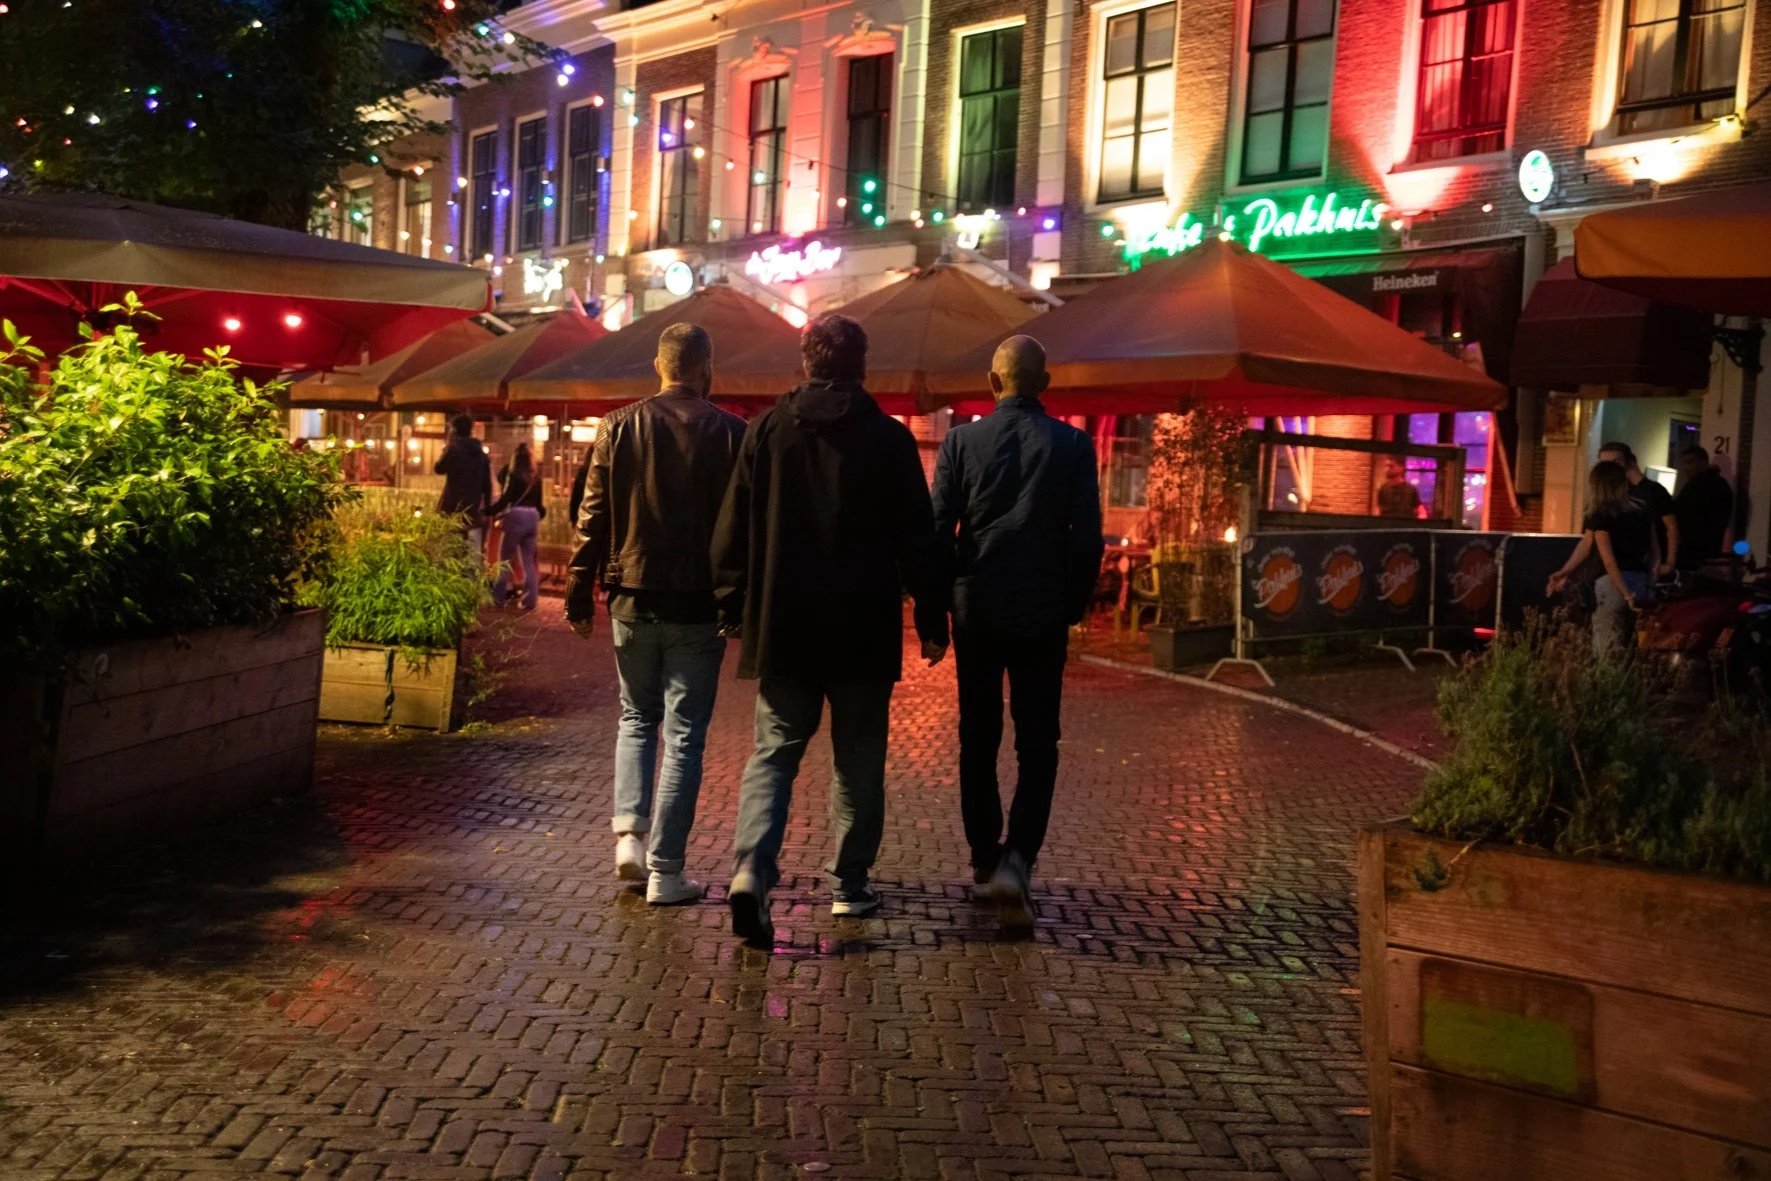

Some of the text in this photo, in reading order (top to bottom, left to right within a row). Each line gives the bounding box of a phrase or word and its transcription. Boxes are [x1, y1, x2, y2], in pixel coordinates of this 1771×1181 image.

[1244, 192, 1386, 252] Pakhuis
[1372, 273, 1438, 291] Heineken
[1713, 435, 1730, 455] 21
